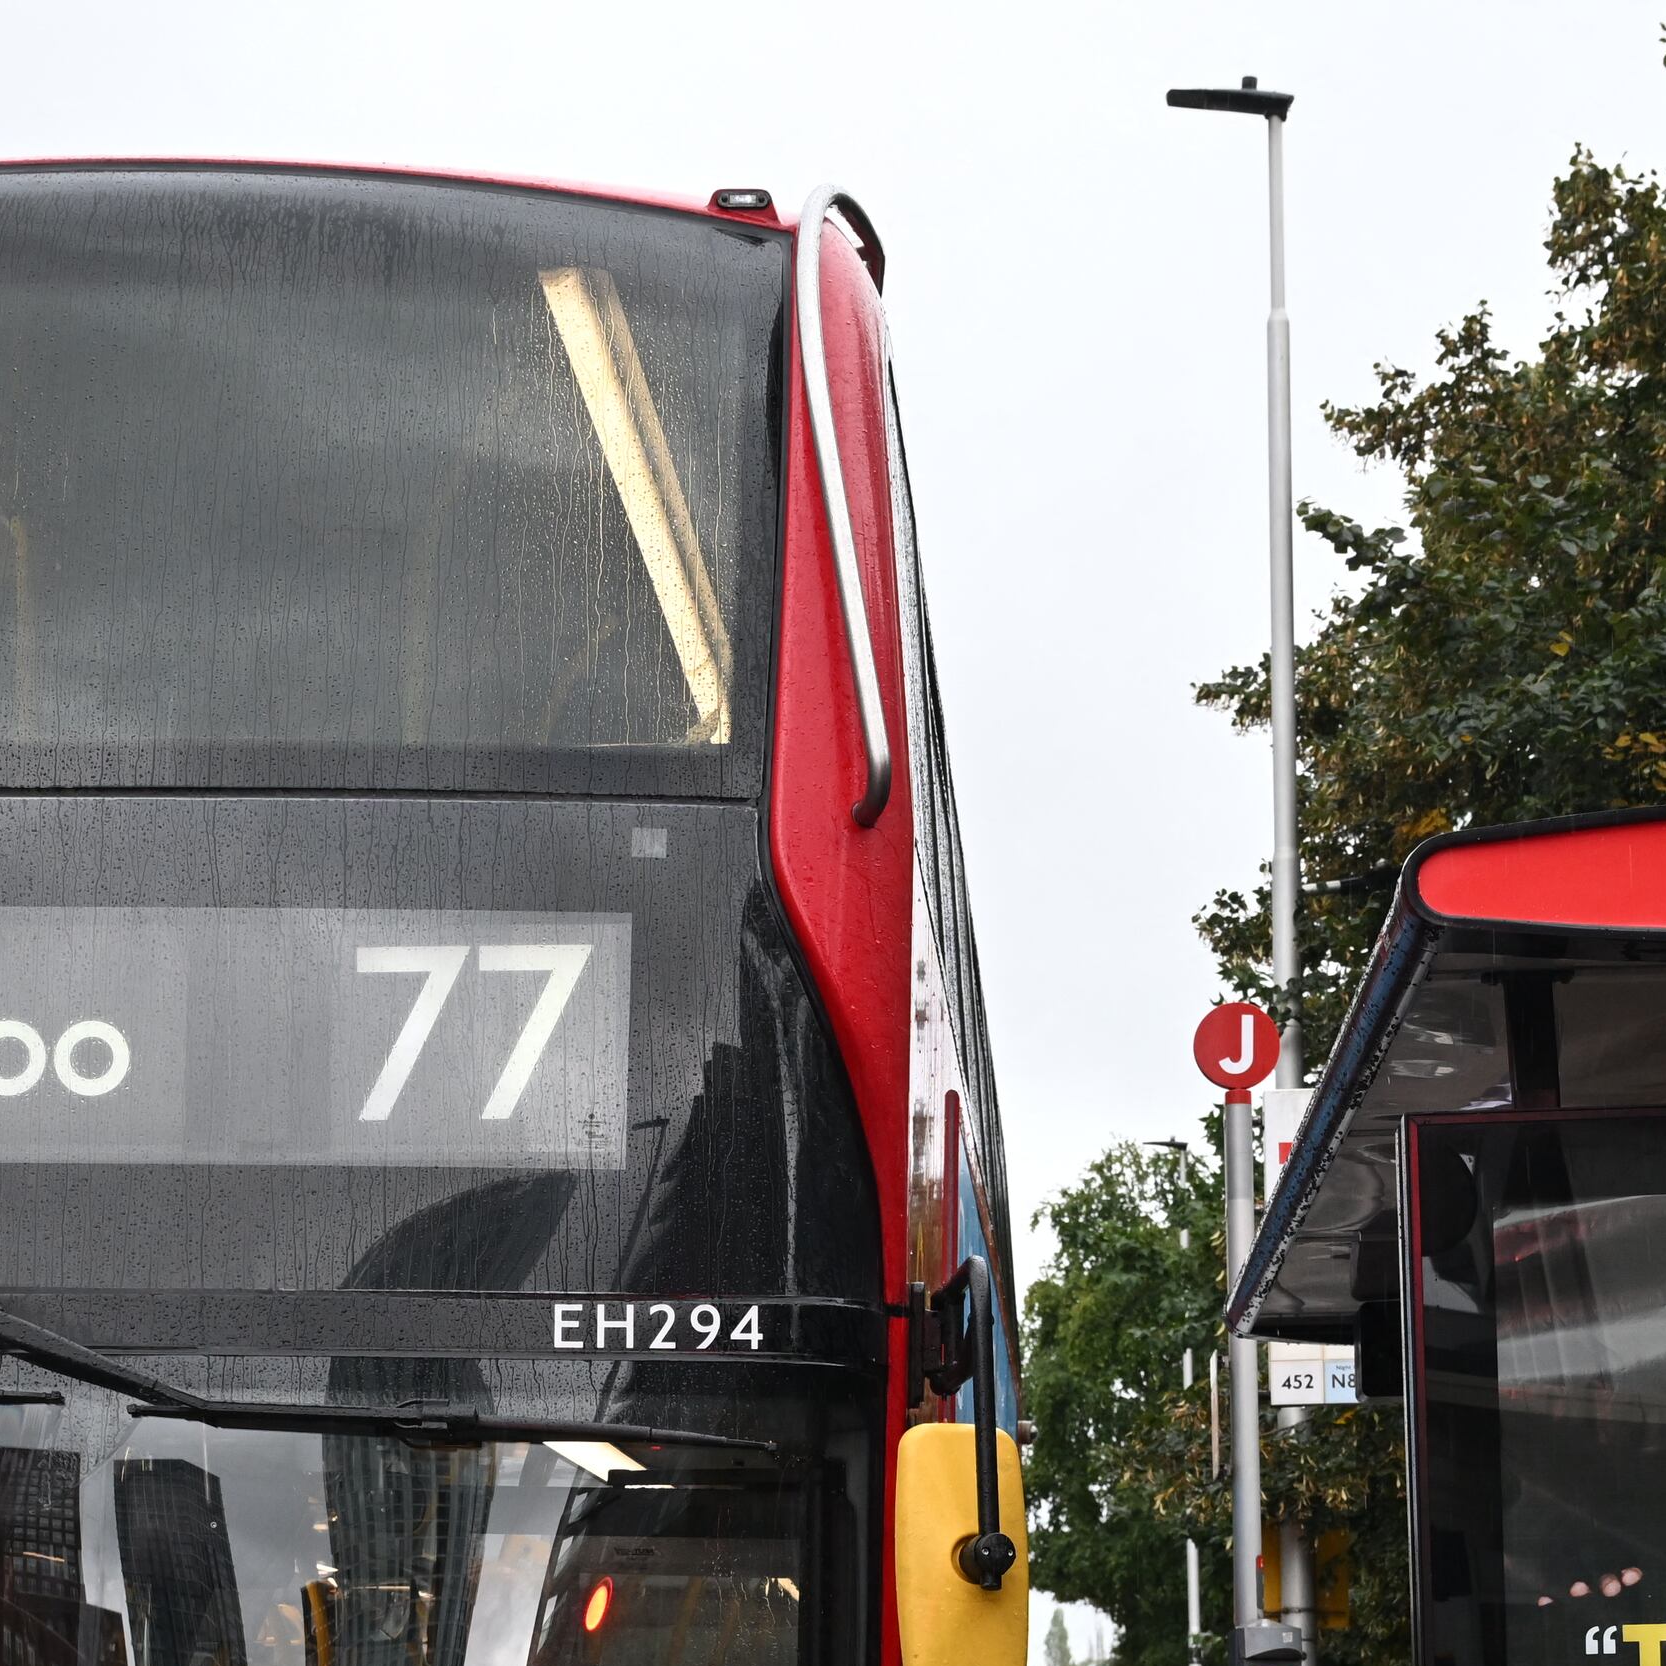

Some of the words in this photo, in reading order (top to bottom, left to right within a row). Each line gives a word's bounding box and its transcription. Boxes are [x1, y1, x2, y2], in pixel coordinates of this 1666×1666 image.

[354, 943, 595, 1121] 77
[1218, 1014, 1254, 1075] J
[553, 1303, 764, 1350] EH294
[1281, 1374, 1314, 1390] 452
